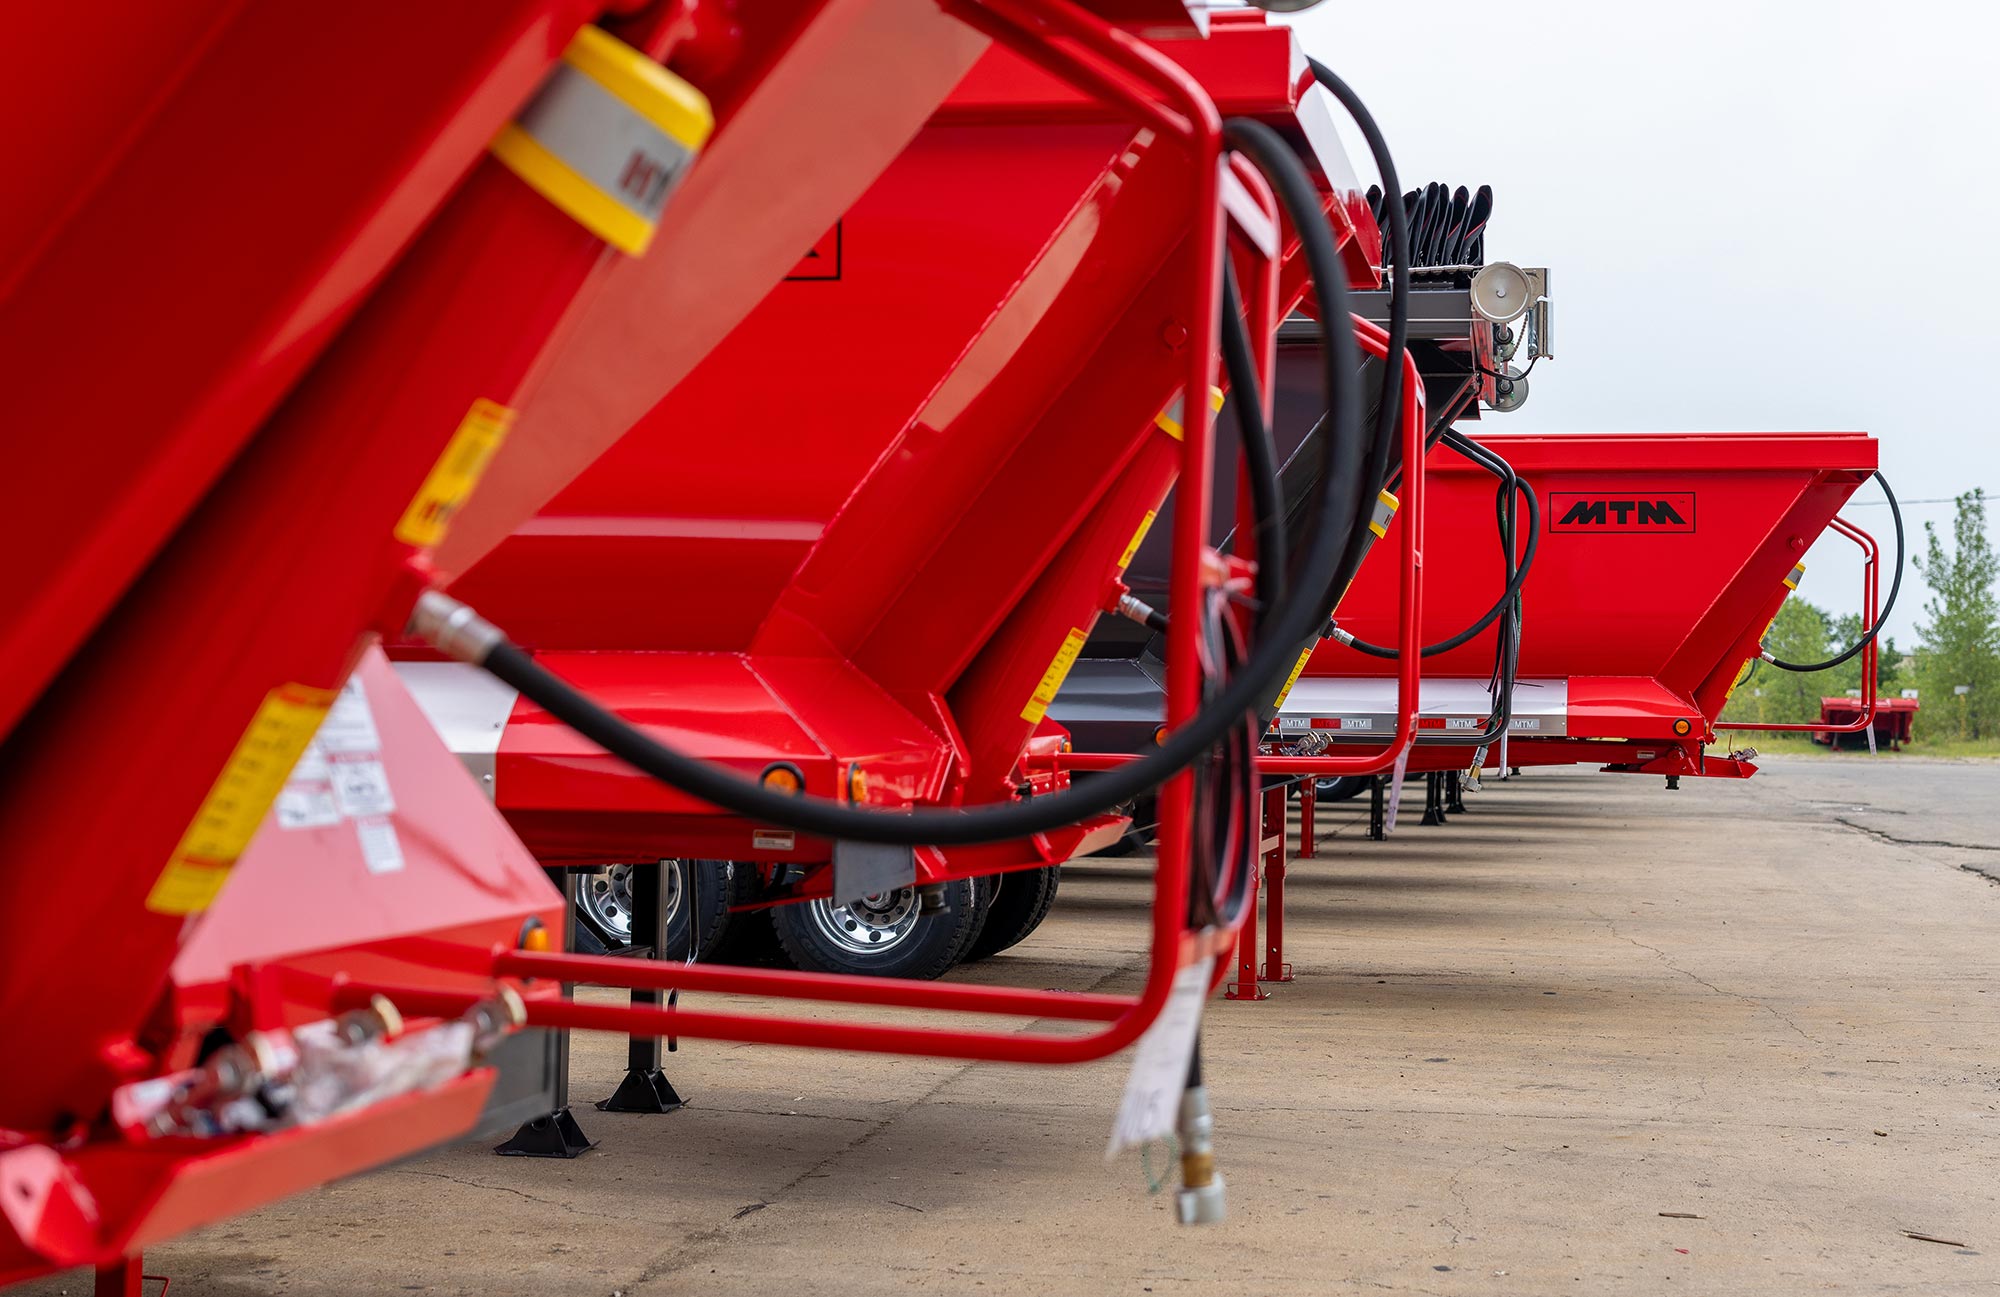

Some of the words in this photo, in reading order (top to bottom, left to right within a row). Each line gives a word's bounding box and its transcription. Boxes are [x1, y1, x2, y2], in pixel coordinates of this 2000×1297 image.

[1558, 501, 1687, 525] MTM
[1286, 719, 1305, 728] MTM
[1347, 720, 1366, 728] MTM
[1422, 720, 1441, 728] MTM
[1453, 720, 1472, 728] MTM
[1514, 720, 1534, 728] MTM
